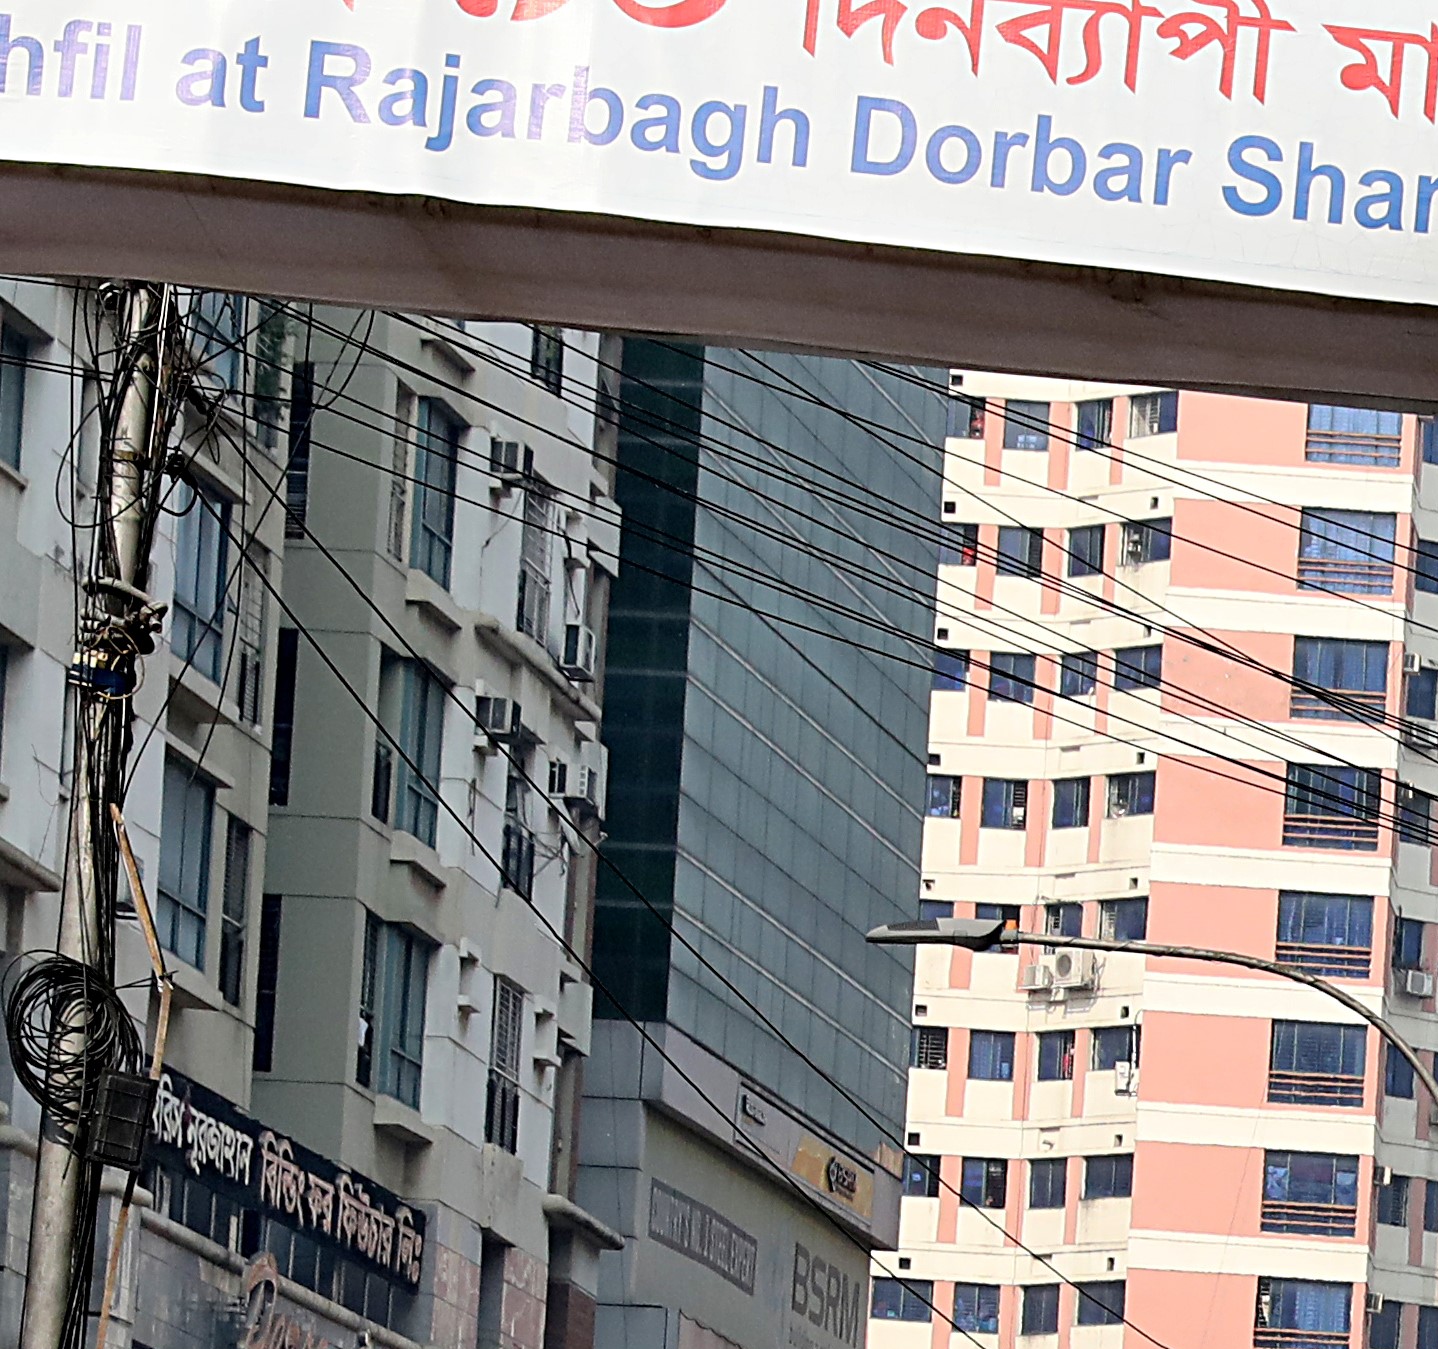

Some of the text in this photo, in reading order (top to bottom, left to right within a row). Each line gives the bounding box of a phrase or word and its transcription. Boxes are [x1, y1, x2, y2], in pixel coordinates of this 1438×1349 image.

[176, 37, 268, 113] at
[305, 39, 808, 180] Rajarbagh
[851, 97, 1191, 206] Dorbar
[792, 1242, 860, 1349] BSRM
